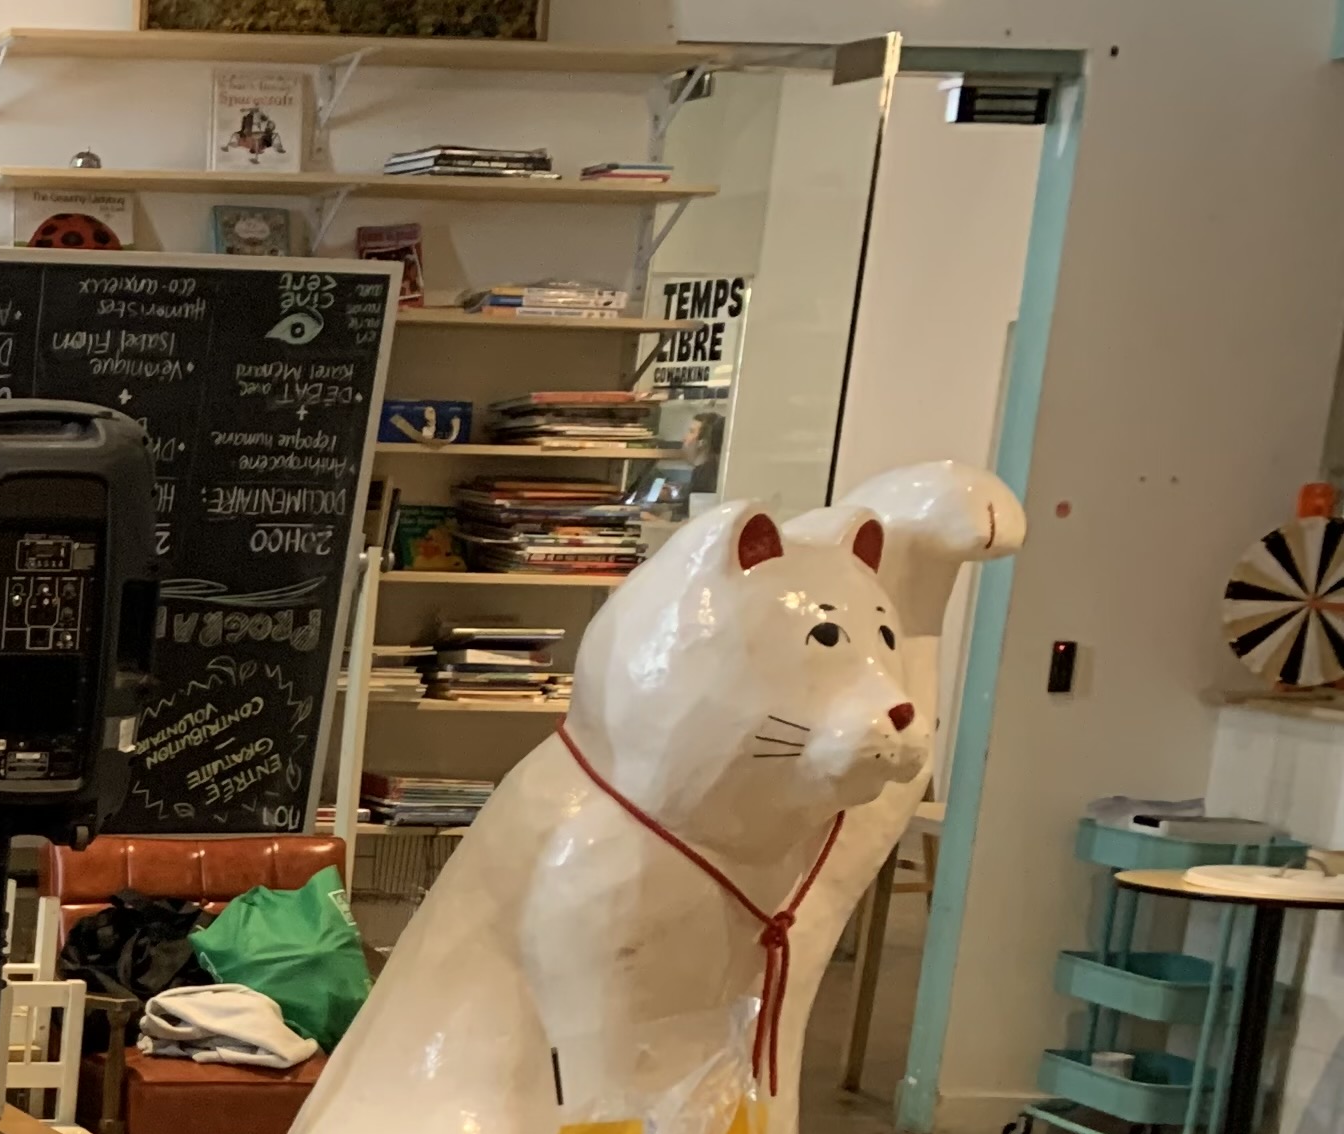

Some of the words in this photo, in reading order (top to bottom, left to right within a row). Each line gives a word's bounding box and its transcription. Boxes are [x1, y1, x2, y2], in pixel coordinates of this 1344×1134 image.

[663, 277, 745, 320] TEMPS
[653, 366, 711, 383] COWORKING
[134, 702, 218, 757] VOLONTAIR
[145, 696, 265, 771] CONTRIBUTION
[186, 737, 273, 791] GRATUITE
[204, 753, 282, 806] ENTRÉE
